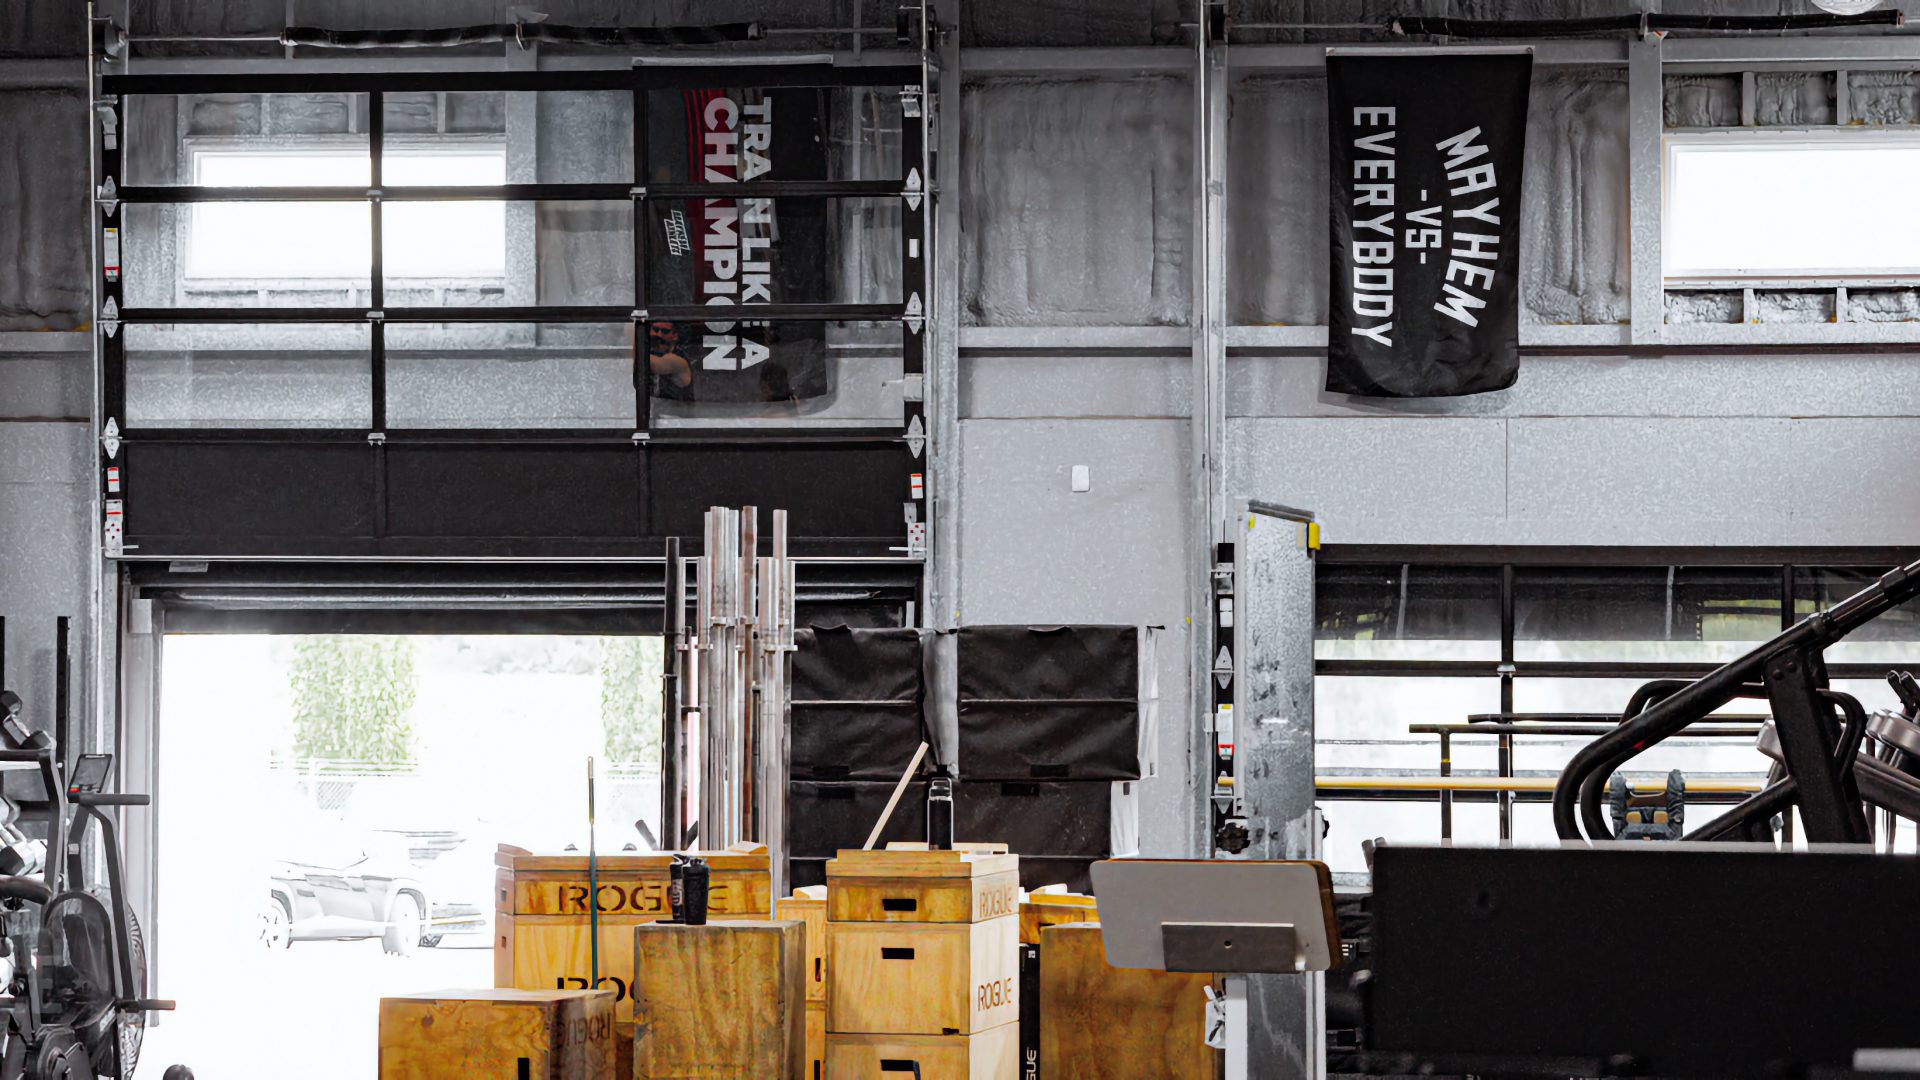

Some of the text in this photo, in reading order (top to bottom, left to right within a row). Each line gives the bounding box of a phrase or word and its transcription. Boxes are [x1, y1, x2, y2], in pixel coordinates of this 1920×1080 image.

[744, 97, 771, 223] TRAN
[1351, 106, 1396, 347] EVERYBODY
[1433, 126, 1500, 328] MAYHEM
[741, 337, 770, 370] A
[558, 885, 729, 912] ROGE
[979, 886, 1012, 918] ROGUE
[978, 977, 1012, 1012] ROGUE
